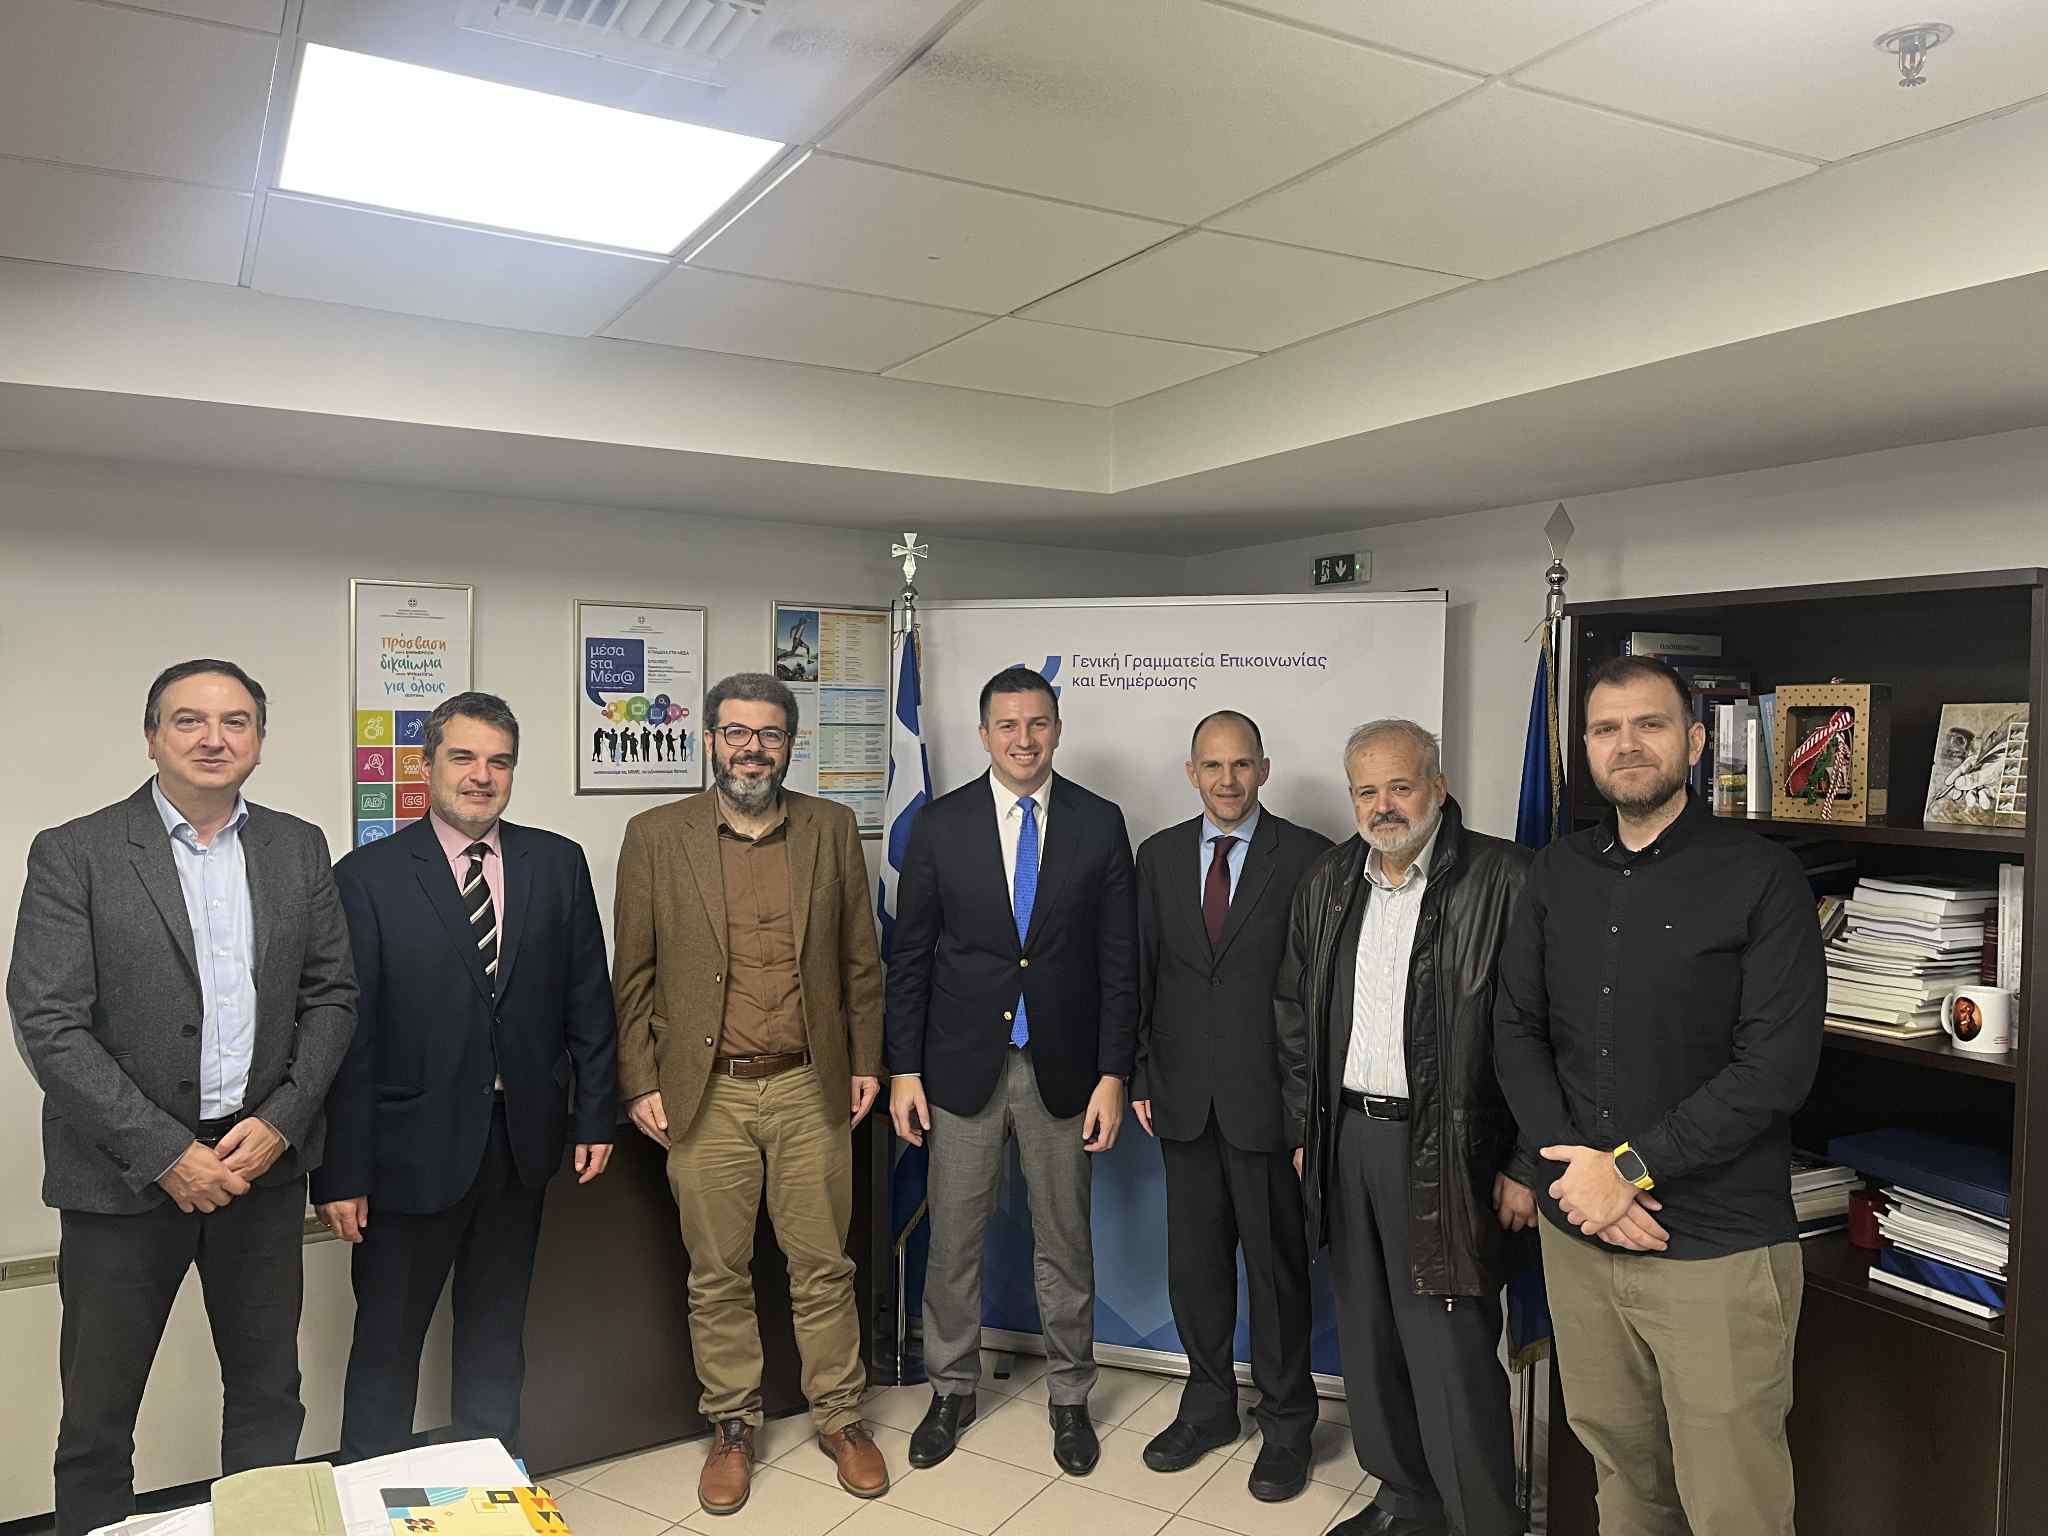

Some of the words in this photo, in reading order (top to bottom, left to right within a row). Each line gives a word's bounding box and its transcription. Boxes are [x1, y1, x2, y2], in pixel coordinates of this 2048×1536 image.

[590, 643, 625, 659] μέσα
[380, 653, 442, 673] δικαίωμα
[1072, 652, 1119, 671] Γενική
[1124, 651, 1216, 671] Γραμματεία
[1219, 651, 1328, 670] Επικοινωνίας
[384, 681, 405, 695] για
[410, 676, 446, 693] όλους
[590, 669, 635, 685] Μέσ@
[1072, 676, 1095, 687] και
[1099, 672, 1198, 690] Ενημέρωσης
